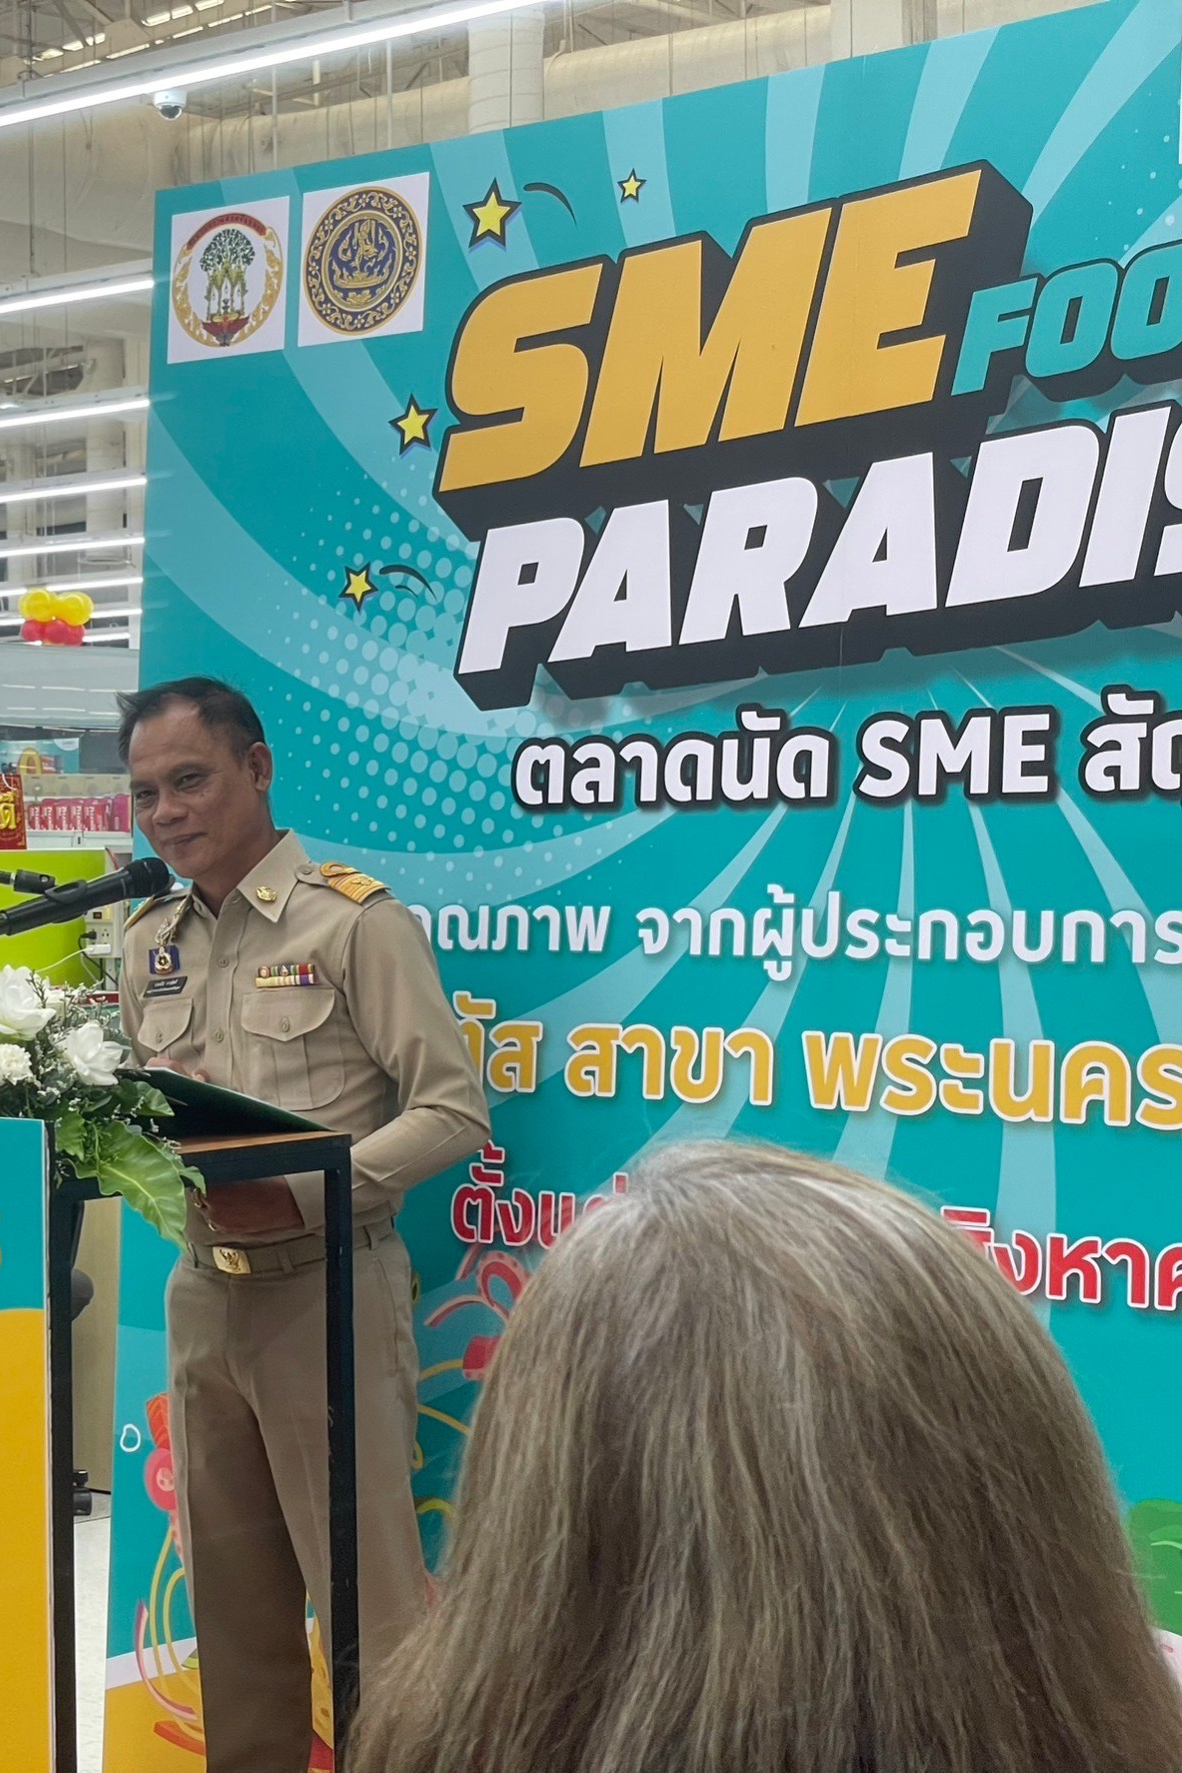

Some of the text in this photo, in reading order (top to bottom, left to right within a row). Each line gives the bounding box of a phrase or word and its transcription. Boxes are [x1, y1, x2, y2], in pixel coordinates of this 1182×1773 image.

[439, 169, 983, 493] SME
[458, 405, 1182, 674] PARADI
[515, 711, 830, 803] ตลาดนัด
[858, 713, 1050, 798] SME
[564, 1022, 774, 1107] สาขา
